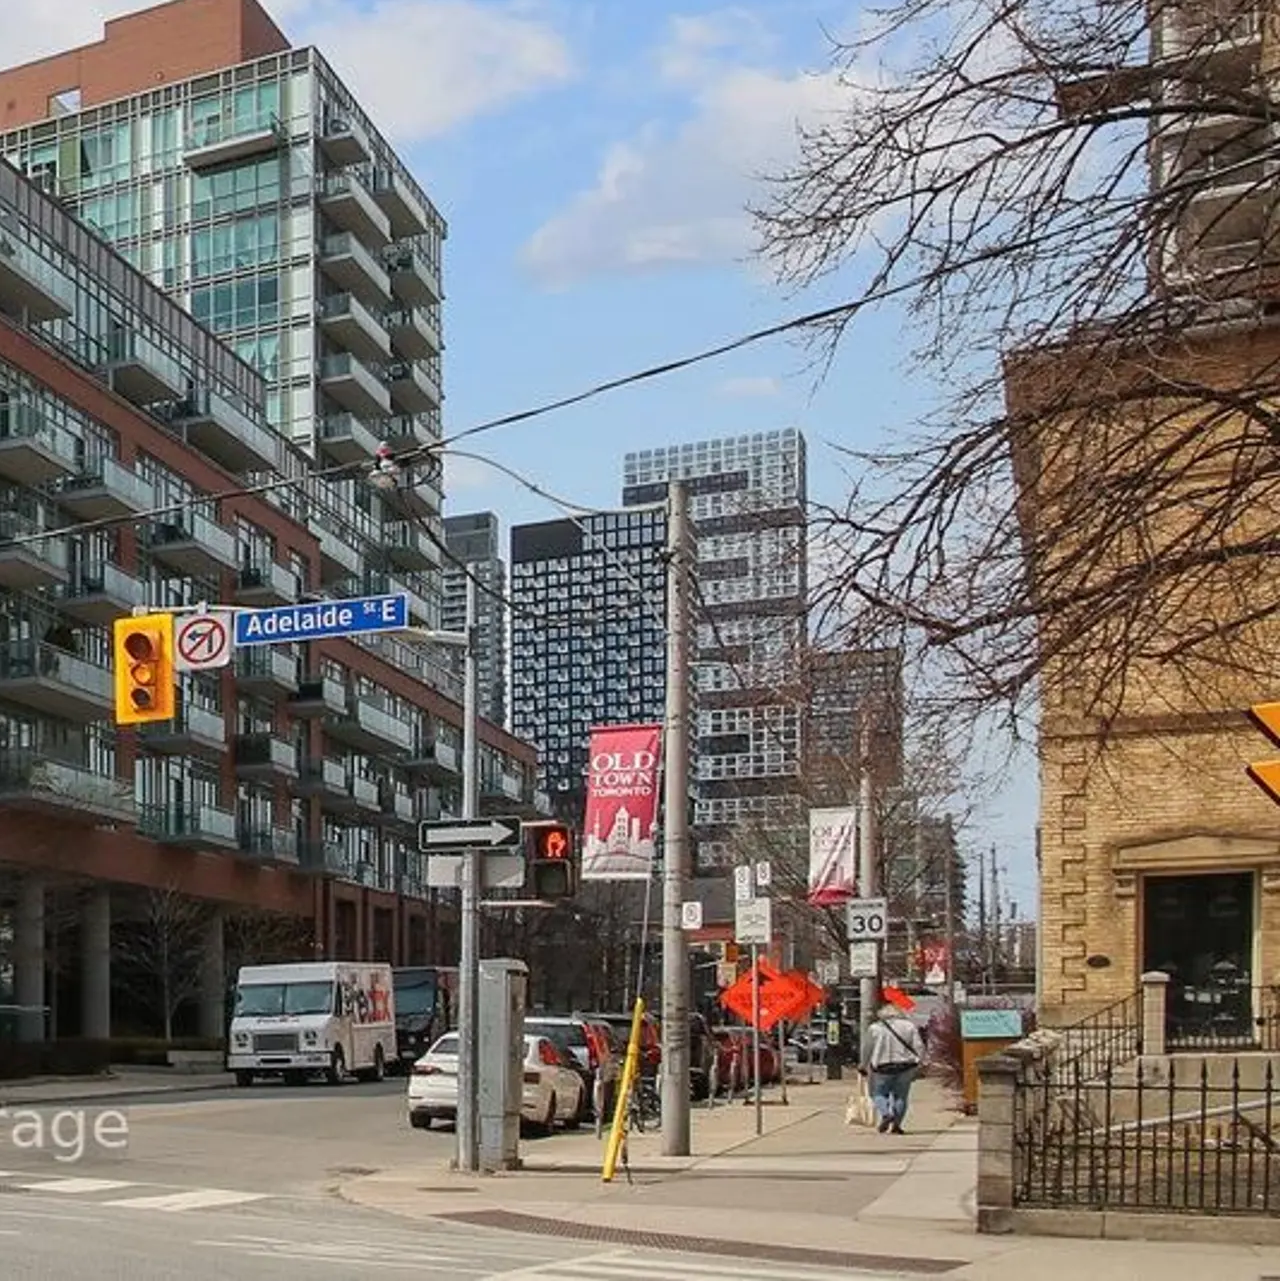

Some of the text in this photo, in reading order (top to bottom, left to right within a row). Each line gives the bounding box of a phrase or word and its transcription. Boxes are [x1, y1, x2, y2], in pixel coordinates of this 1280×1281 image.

[246, 606, 353, 636] Adelaide
[382, 599, 397, 621] E
[591, 751, 655, 773] OLD
[593, 771, 653, 787] TOWN
[592, 785, 653, 798] TORONTO
[852, 914, 883, 934] 30
